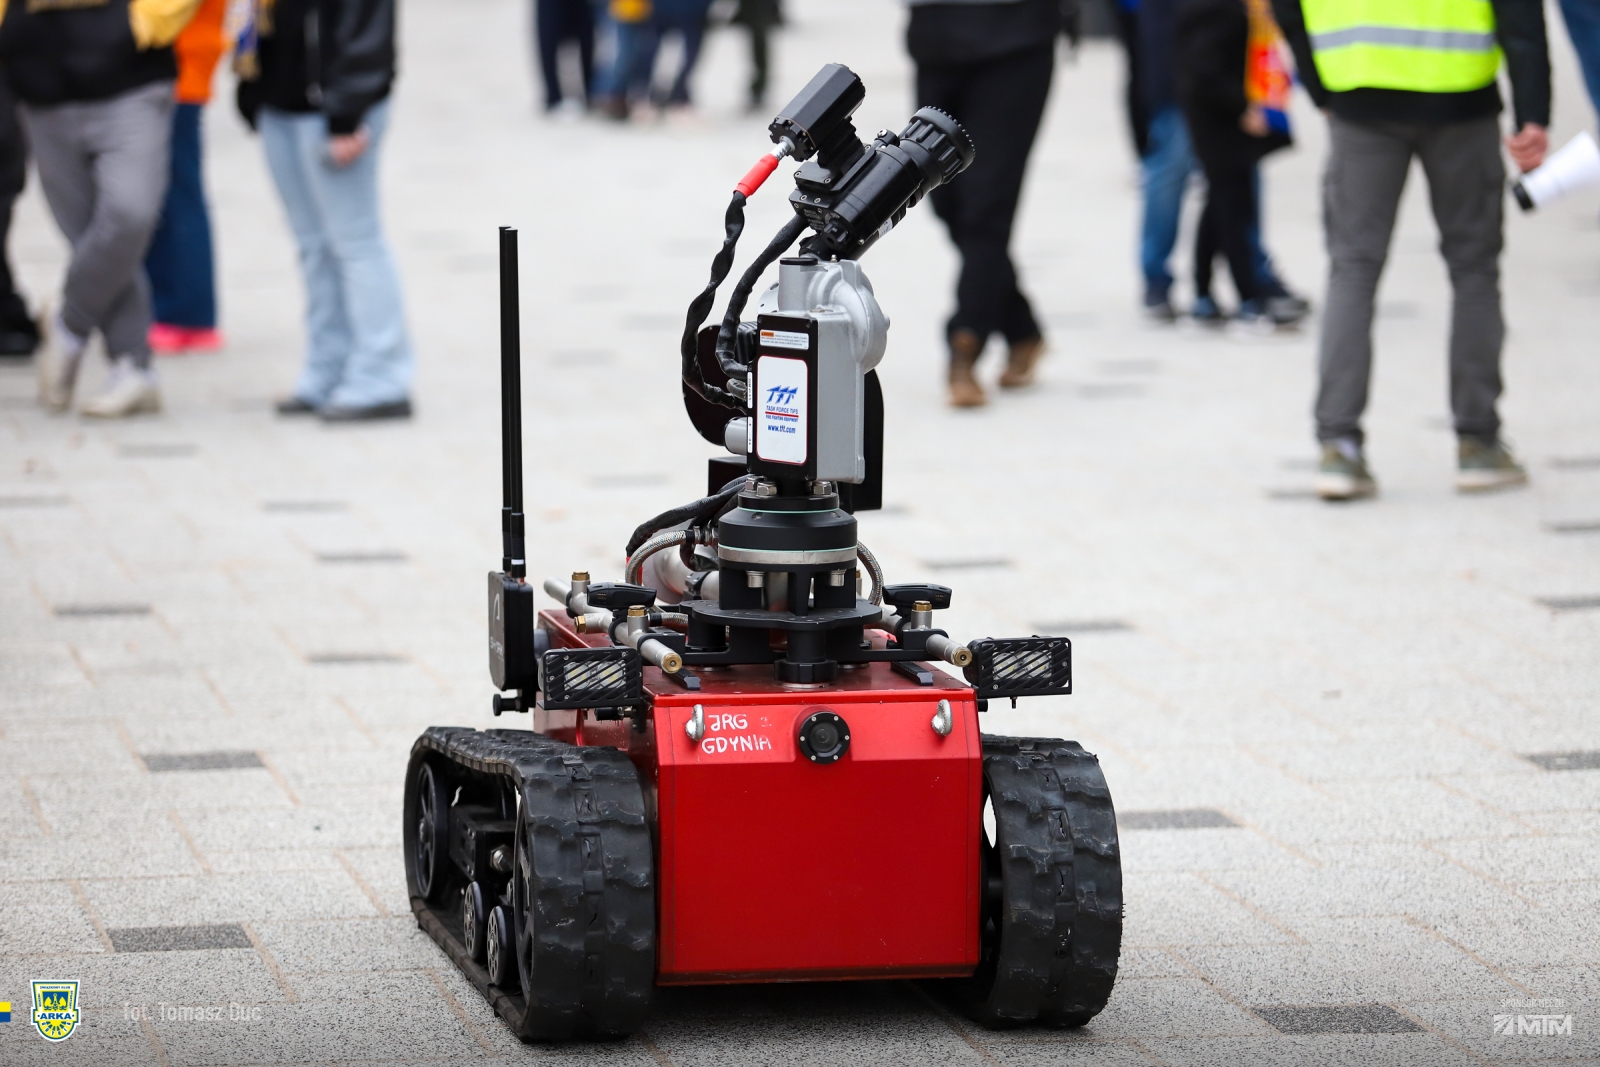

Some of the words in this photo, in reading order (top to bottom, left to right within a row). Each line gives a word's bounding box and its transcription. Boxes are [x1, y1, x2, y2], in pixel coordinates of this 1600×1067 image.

[768, 425, 796, 434] www.tft.com
[708, 713, 748, 732] JRG
[701, 734, 772, 754] GDYNIA
